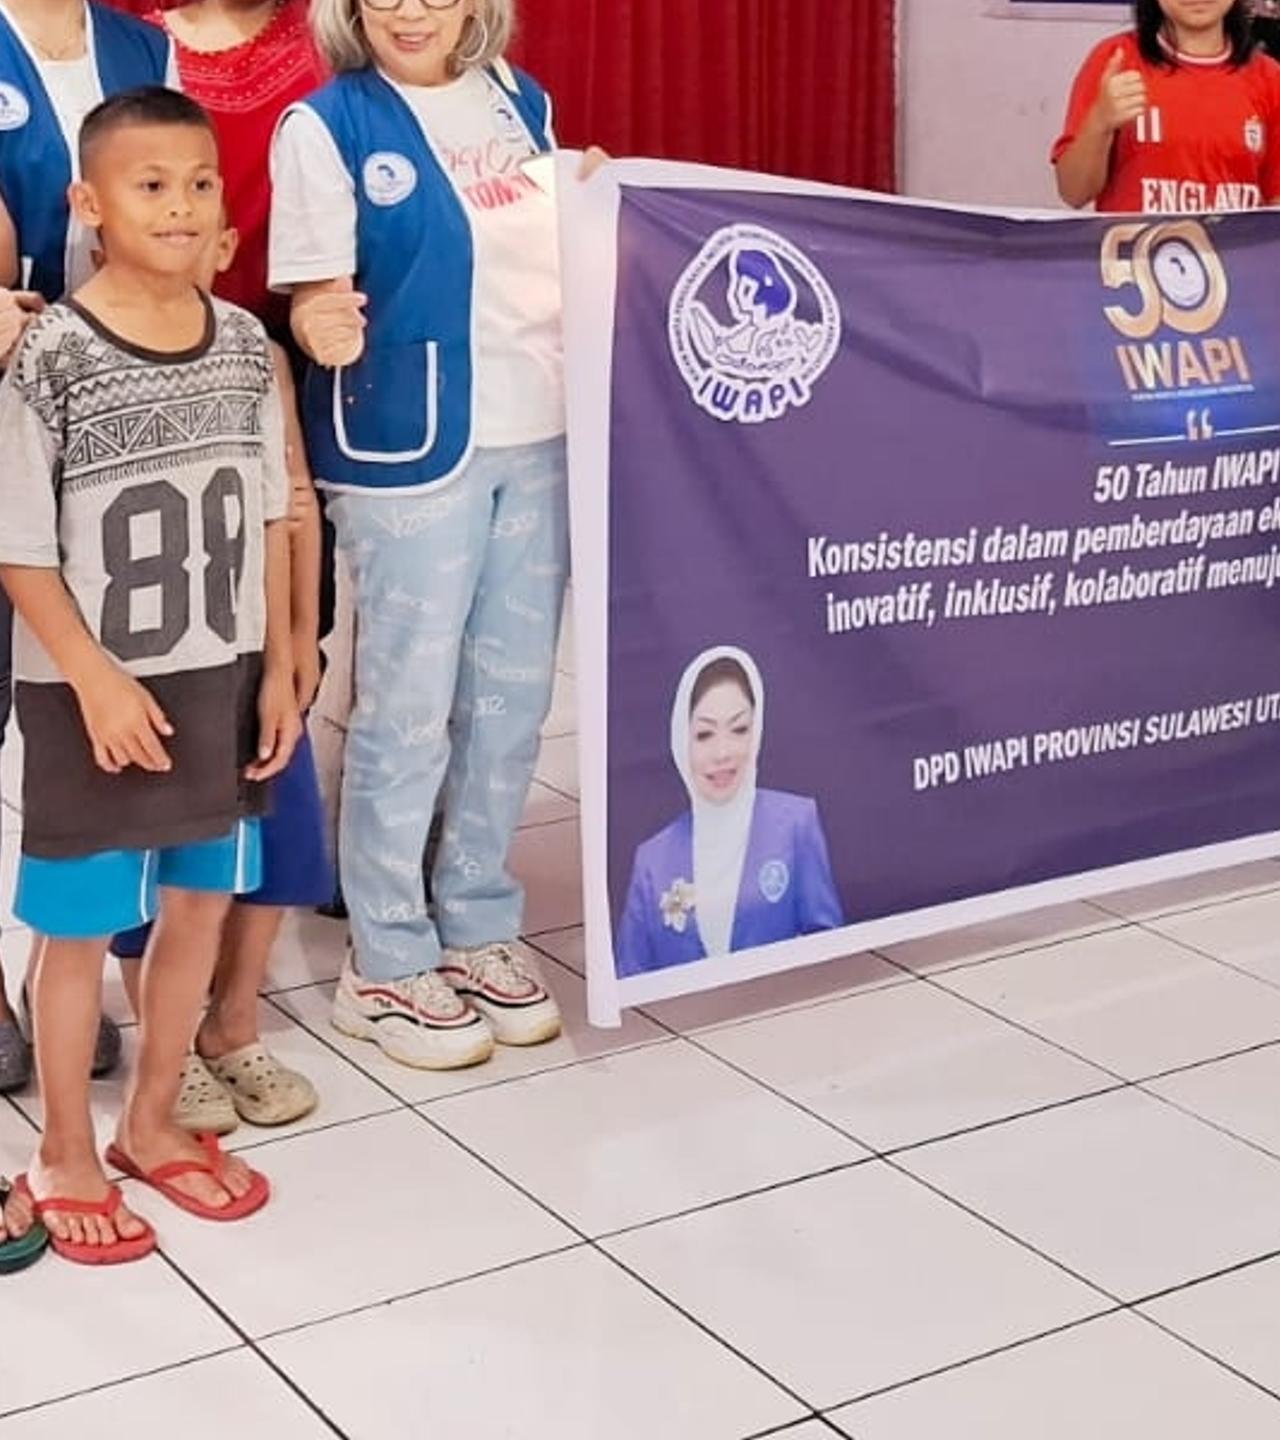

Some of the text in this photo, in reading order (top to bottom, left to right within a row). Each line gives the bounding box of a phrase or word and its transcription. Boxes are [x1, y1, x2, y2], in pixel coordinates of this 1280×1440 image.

[1141, 177, 1261, 212] ENGLAND
[1101, 218, 1229, 340] 50
[697, 374, 804, 416] IWAPI
[1116, 336, 1251, 391] IWAPI
[1093, 464, 1131, 503] 50
[1135, 460, 1207, 499] Tahun
[100, 466, 246, 662] 88
[807, 527, 978, 578] Konsistensi
[983, 523, 1068, 563] dalam
[1072, 508, 1254, 564] pemberdayaan
[826, 581, 936, 634] inovatif,
[943, 572, 1057, 619] inklusif,
[1064, 554, 1205, 608] kolaboratif
[912, 751, 961, 792] DPD
[964, 736, 1028, 779] IWAPI
[1032, 719, 1140, 765] PROVINSI
[1143, 698, 1253, 745] SULAWESI
